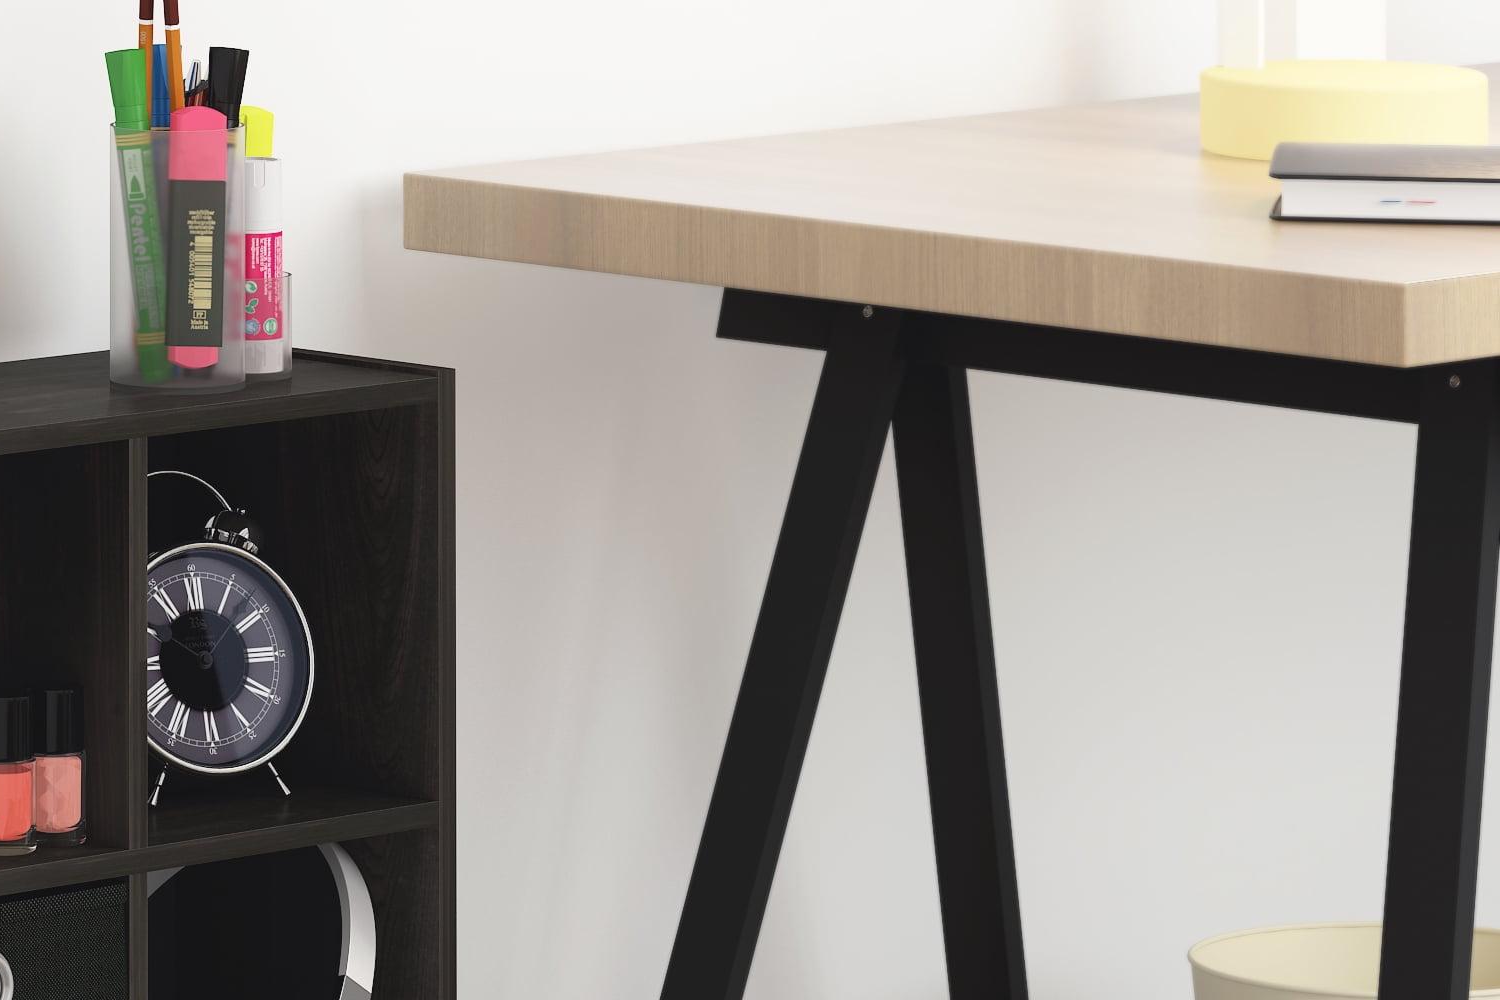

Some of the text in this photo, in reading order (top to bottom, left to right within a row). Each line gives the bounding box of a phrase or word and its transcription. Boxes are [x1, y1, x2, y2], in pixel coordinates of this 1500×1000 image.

[129, 202, 152, 261] Pentel
[187, 563, 196, 572] 60
[230, 573, 236, 581] 5
[148, 579, 157, 589] 55
[261, 603, 271, 613] 10
[278, 649, 286, 658] 15
[272, 694, 282, 705] 20
[248, 730, 258, 741] 25
[167, 737, 177, 747] 35
[209, 747, 219, 756] 30
